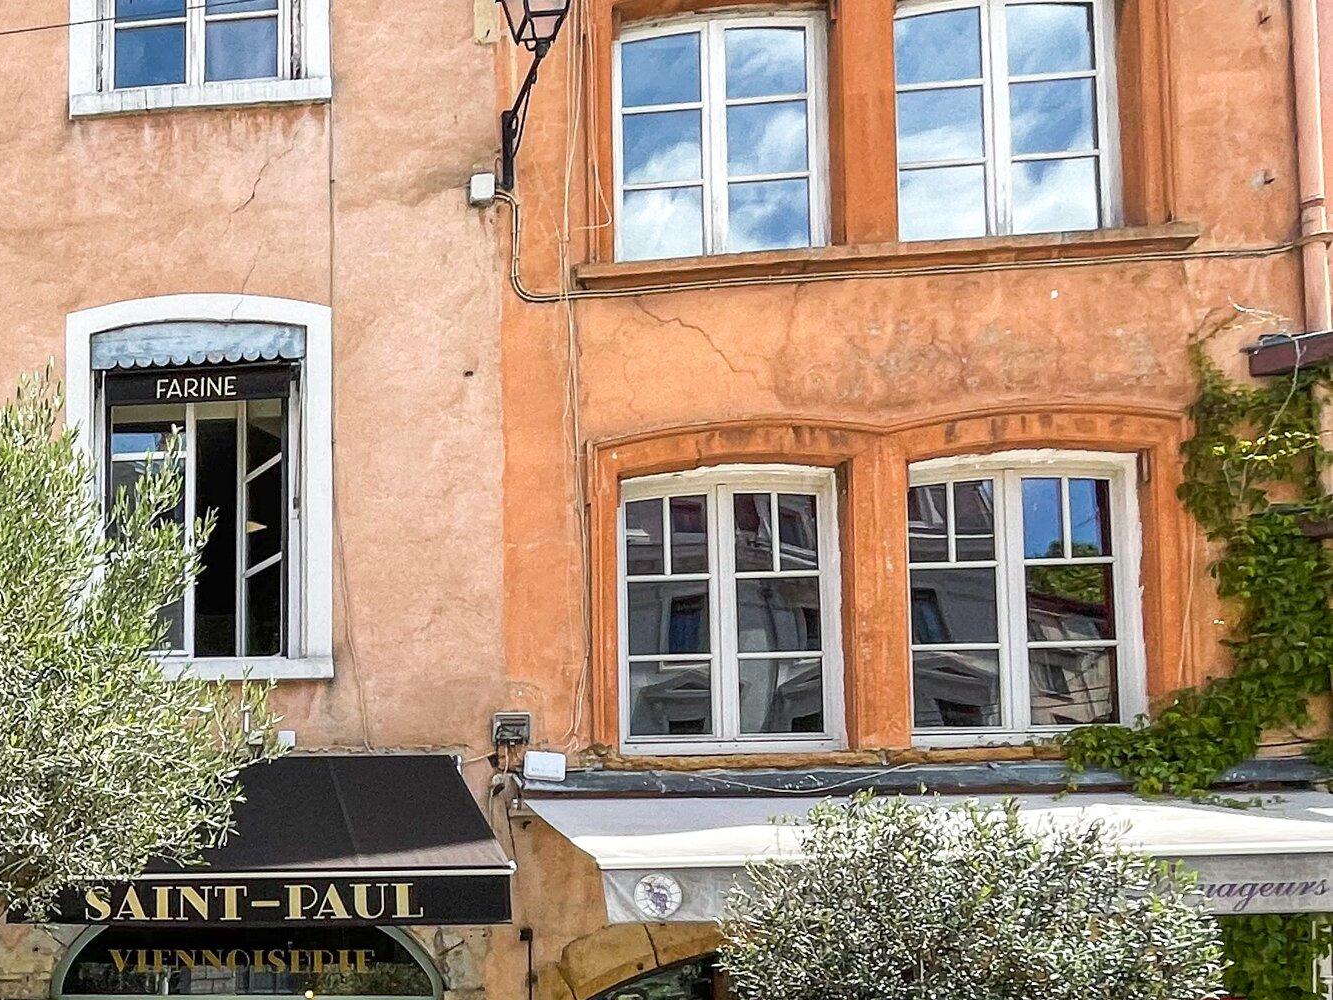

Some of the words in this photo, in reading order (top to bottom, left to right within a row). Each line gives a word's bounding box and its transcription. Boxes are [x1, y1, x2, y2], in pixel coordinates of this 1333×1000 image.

[155, 376, 237, 399] FARINE
[85, 883, 424, 921] SAINT-PAUL
[108, 949, 376, 974] VIENNOISERIE
